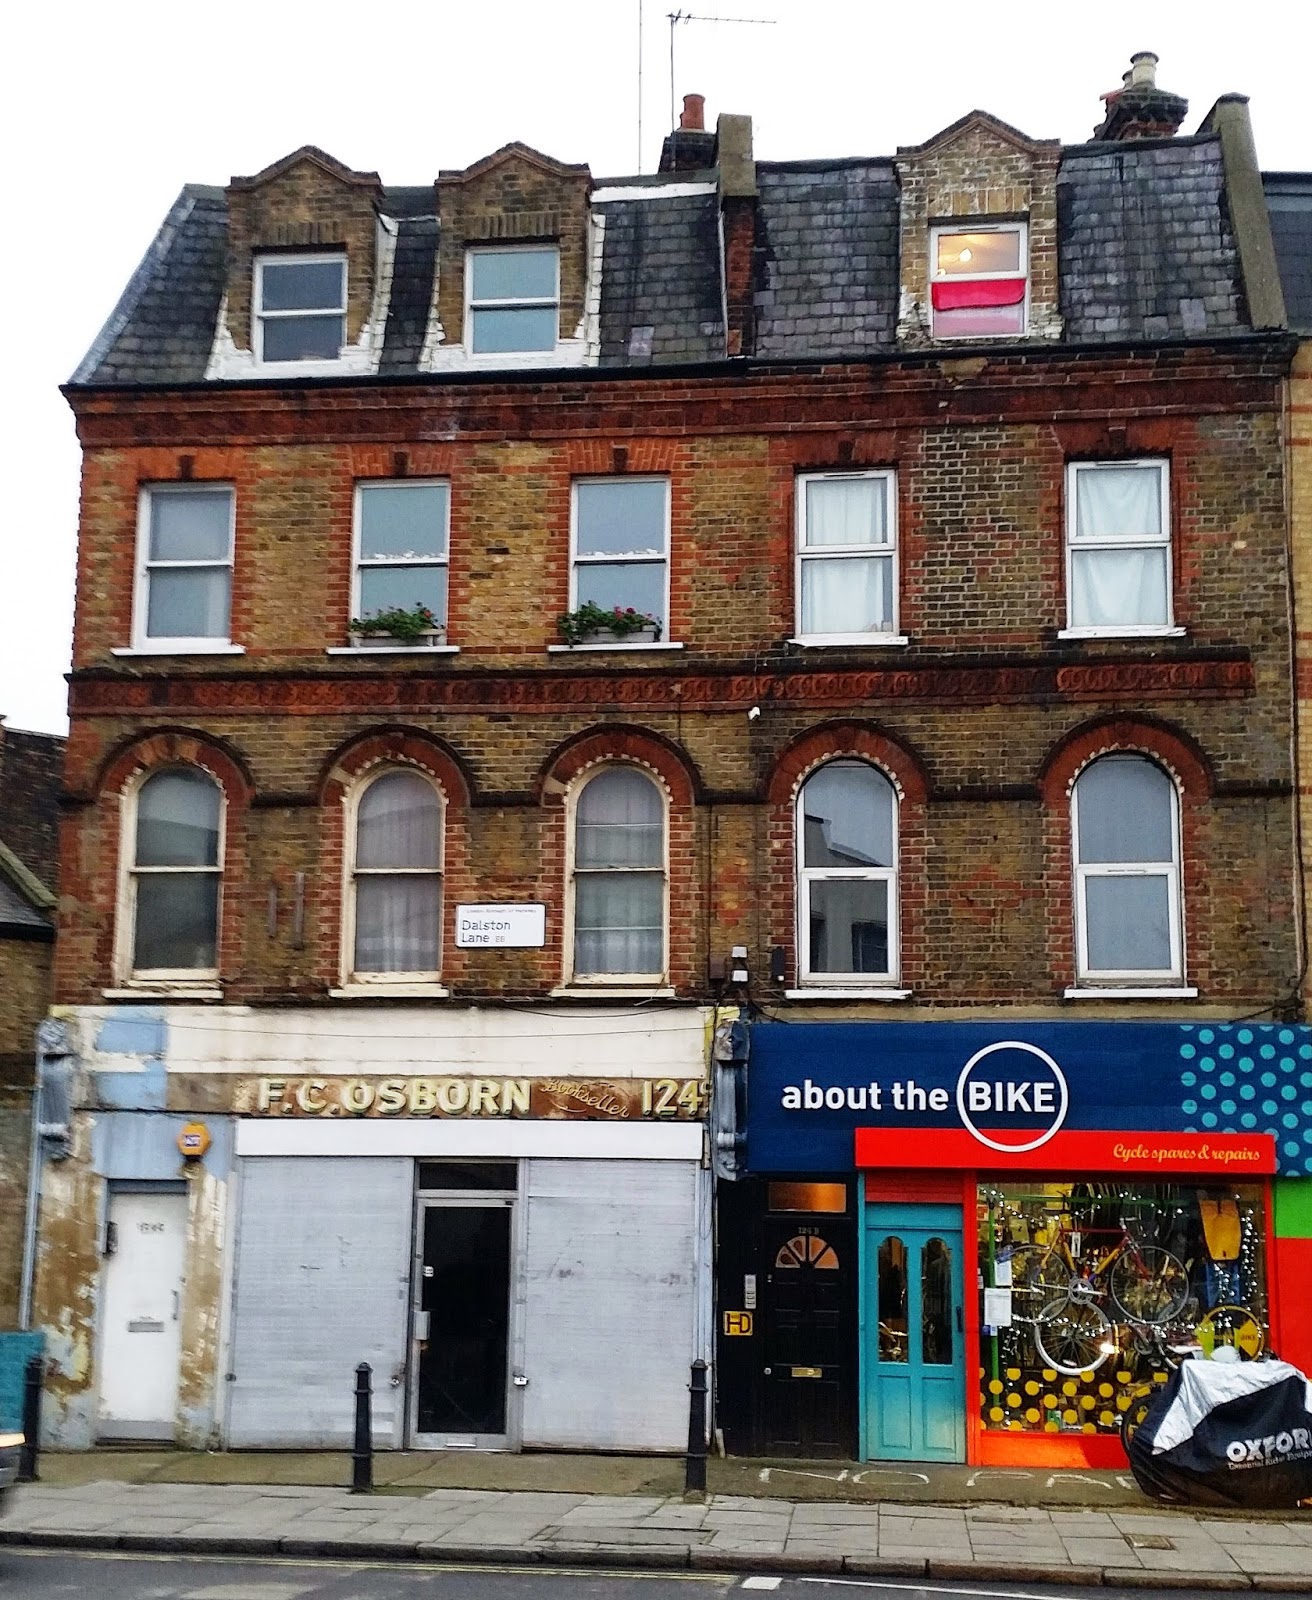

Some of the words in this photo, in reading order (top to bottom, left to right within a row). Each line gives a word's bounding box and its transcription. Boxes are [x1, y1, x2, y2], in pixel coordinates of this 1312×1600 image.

[462, 919, 511, 931] Dalston
[462, 932, 490, 943] Lane
[540, 1077, 630, 1118] Bookseller
[781, 1079, 882, 1110] about
[891, 1080, 949, 1111] the
[969, 1081, 1056, 1113] BIKE
[1113, 1143, 1149, 1162] Cycle
[1151, 1148, 1196, 1163] spares
[1197, 1144, 1210, 1160] &
[1211, 1147, 1261, 1164] repairs
